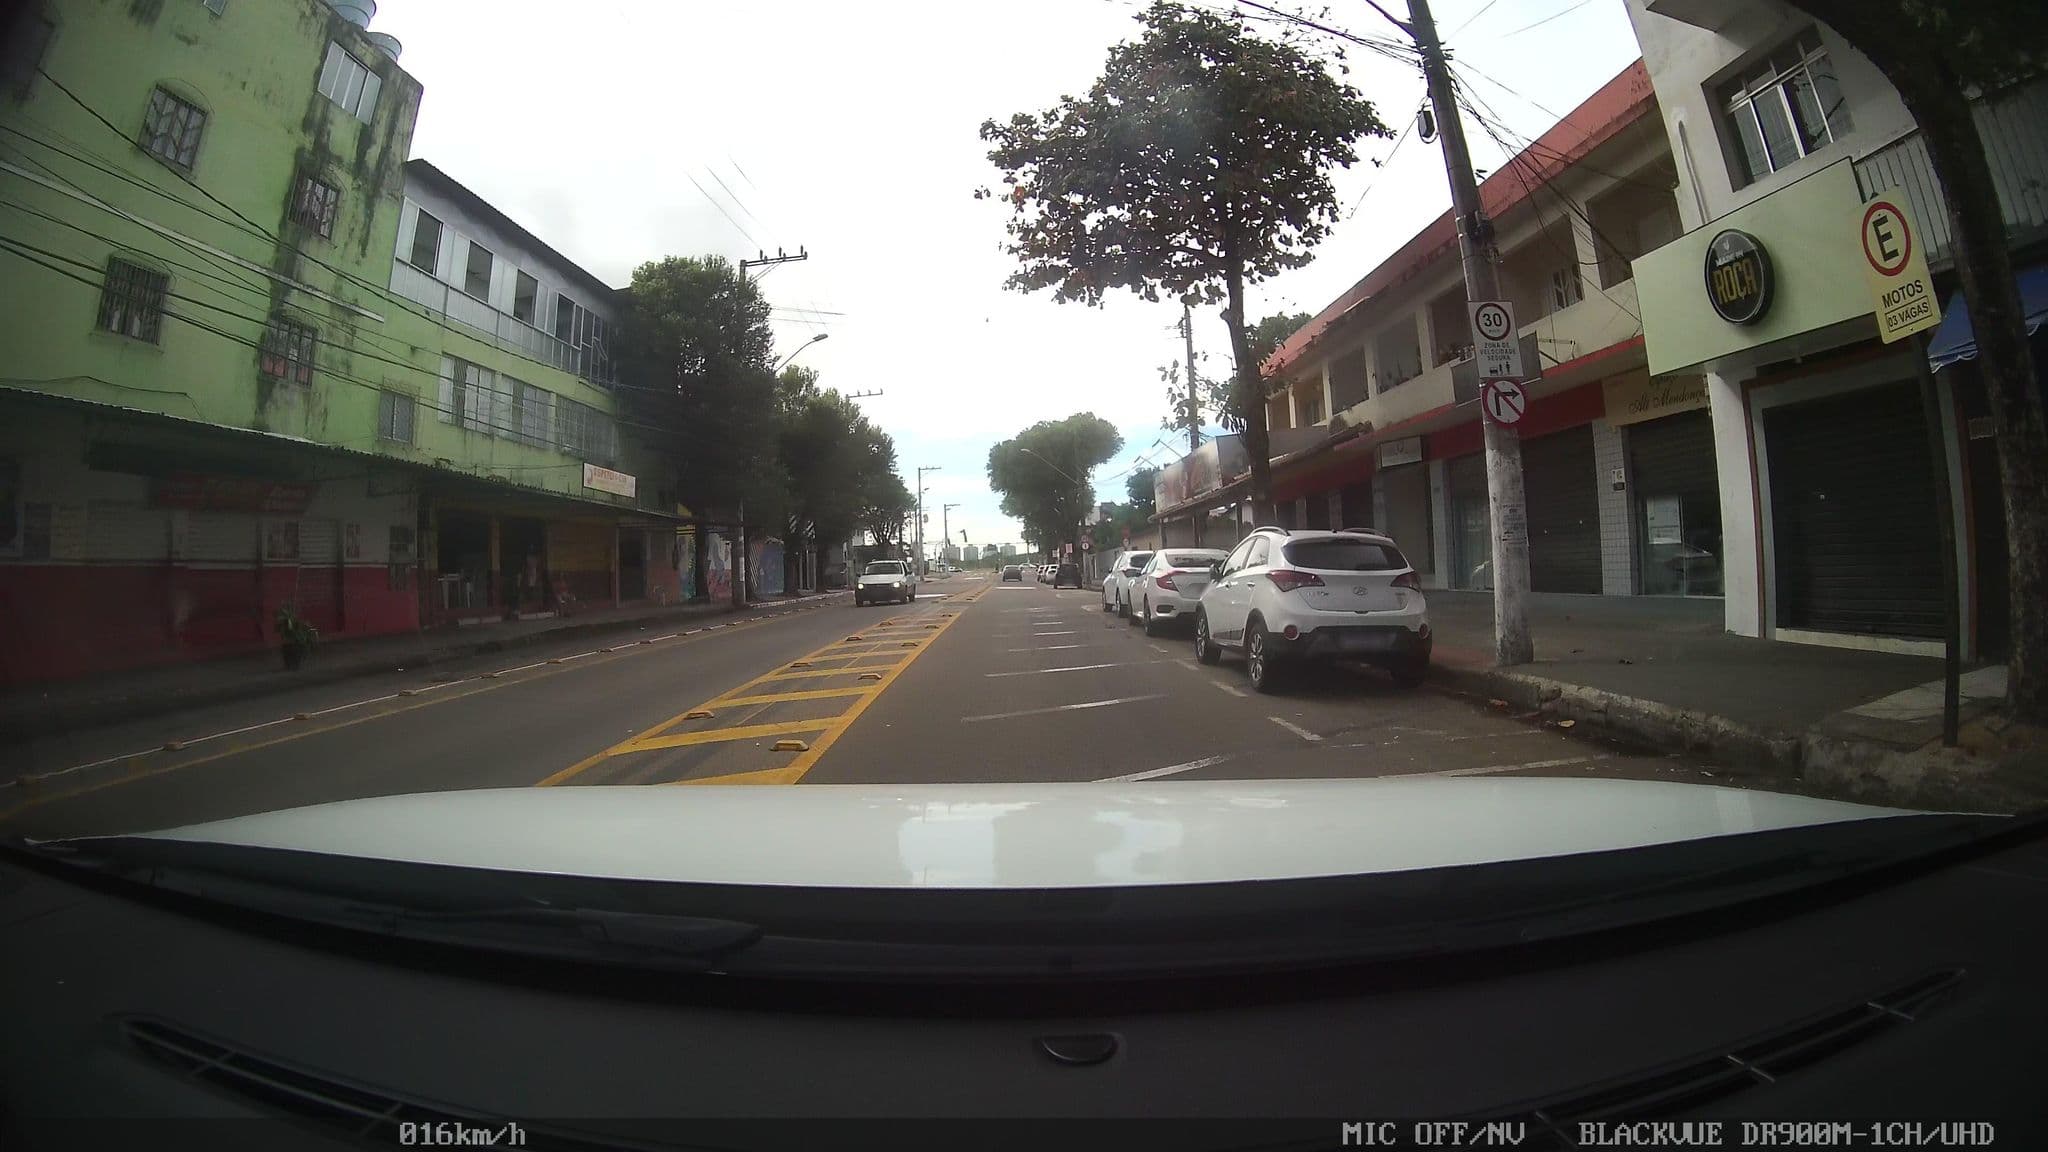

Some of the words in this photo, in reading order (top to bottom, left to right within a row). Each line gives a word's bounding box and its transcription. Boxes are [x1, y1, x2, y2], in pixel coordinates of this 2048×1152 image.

[1872, 215, 1899, 261] E
[1882, 280, 1924, 308] MOTOS
[1482, 312, 1503, 327] 30
[1887, 314, 1898, 328] 03
[1899, 302, 1929, 322] VAGAS
